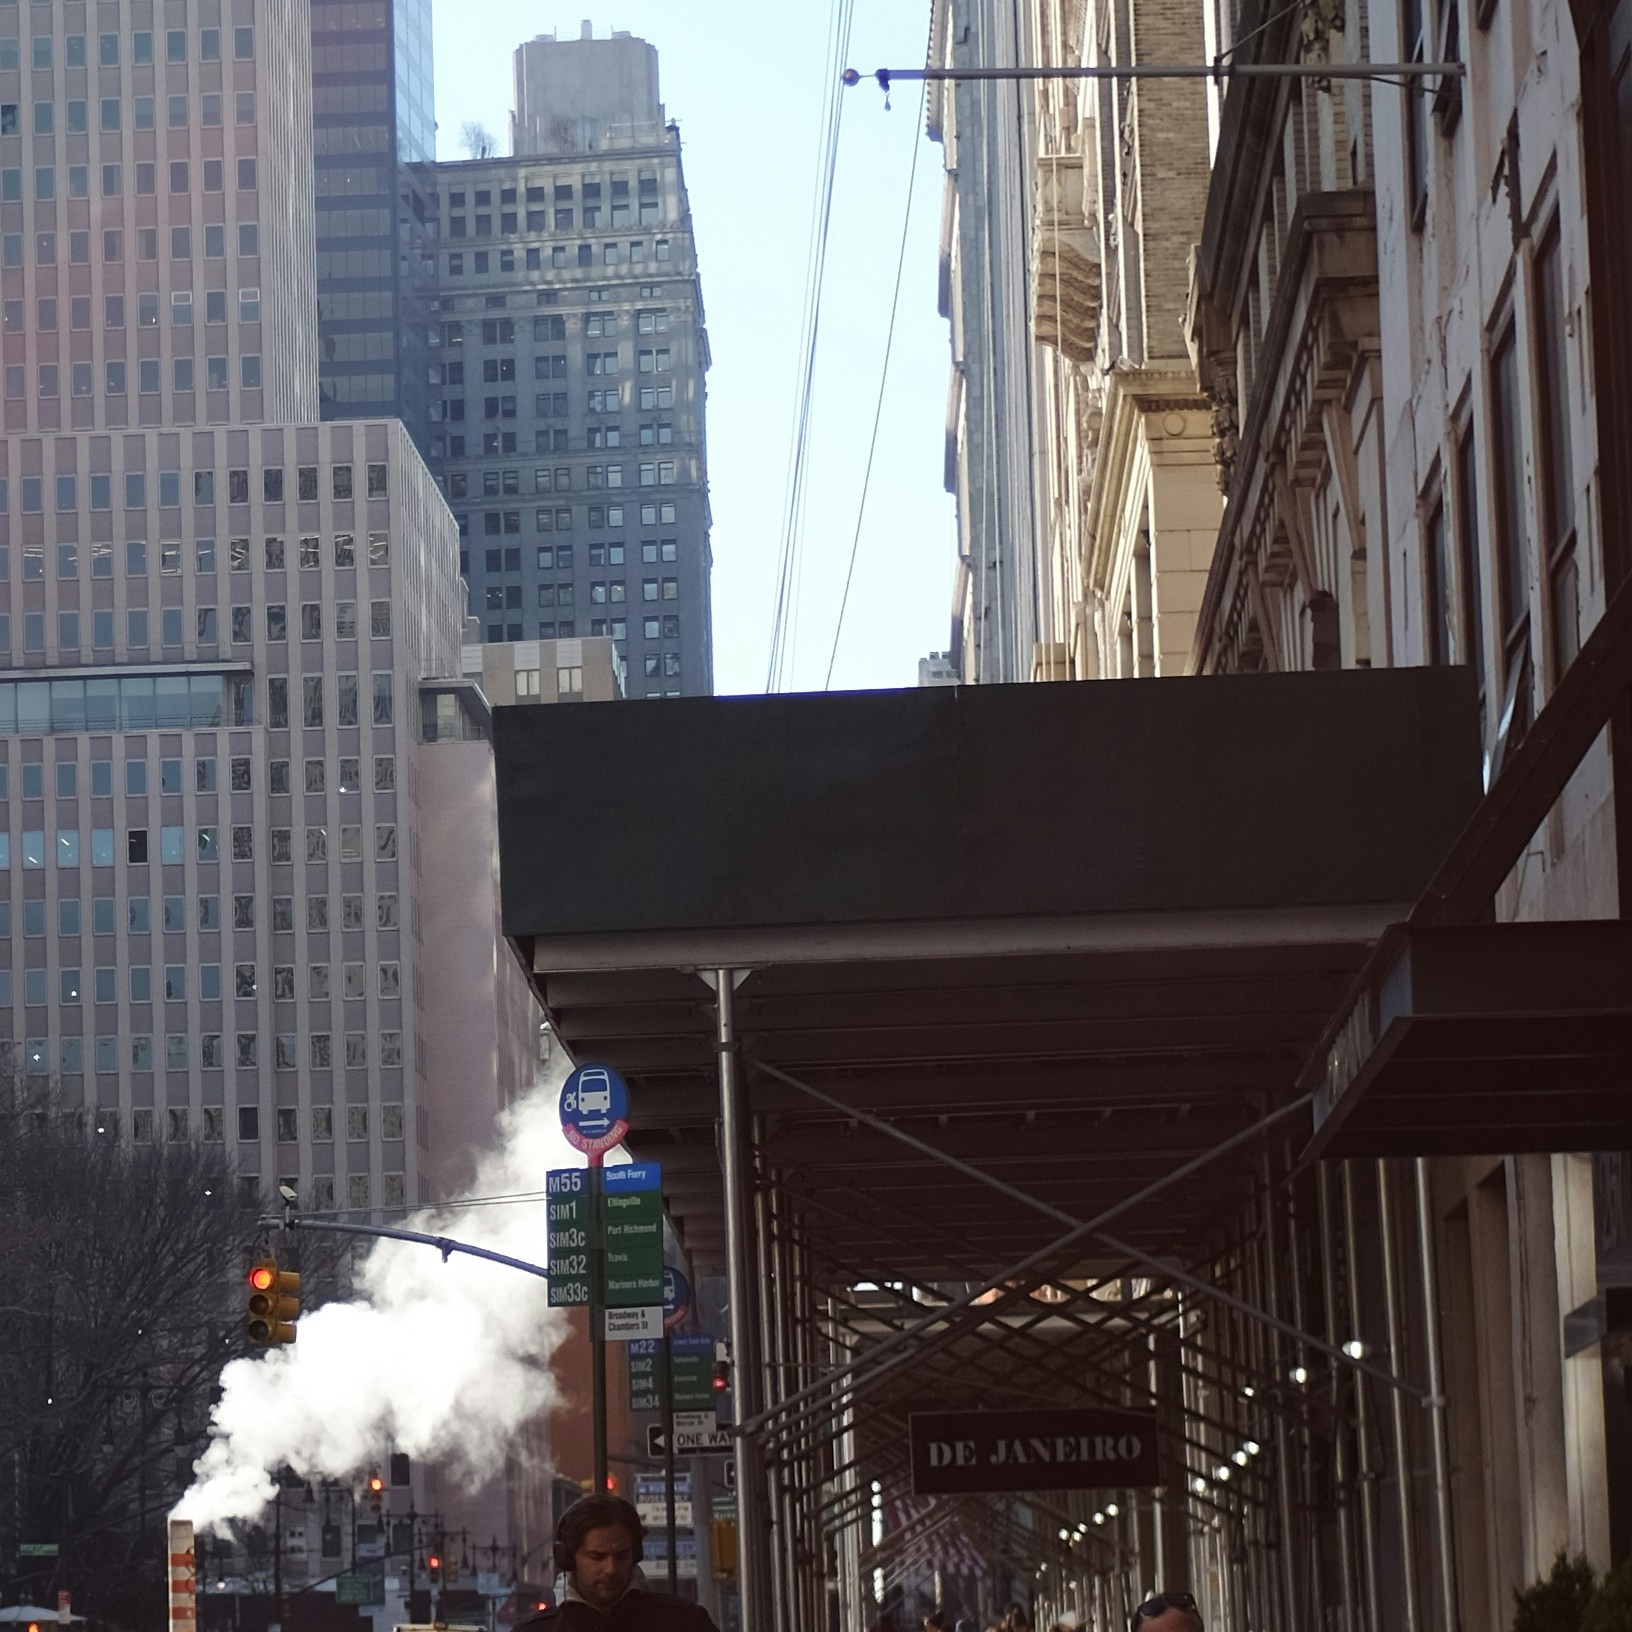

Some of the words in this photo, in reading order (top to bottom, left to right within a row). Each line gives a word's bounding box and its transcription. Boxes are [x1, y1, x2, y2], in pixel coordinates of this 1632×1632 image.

[567, 1129, 581, 1145] NO
[582, 1124, 623, 1150] STANDING
[548, 1171, 582, 1193] M55
[605, 1170, 626, 1181] South
[627, 1169, 647, 1180] Ferry
[549, 1199, 577, 1221] SIM1
[607, 1225, 622, 1235] Port
[623, 1222, 657, 1234] Richmond
[549, 1227, 586, 1249] SIM3c
[549, 1254, 587, 1276] SIM32
[607, 1252, 629, 1263] Travis
[550, 1281, 589, 1304] SIM33c
[607, 1309, 639, 1320] Broadway
[608, 1321, 640, 1332] Chambers
[641, 1320, 649, 1330] St
[630, 1339, 656, 1354] M22
[677, 1433, 704, 1447] ONE
[928, 1440, 977, 1467] DE
[989, 1432, 1142, 1465] JANEIRO
